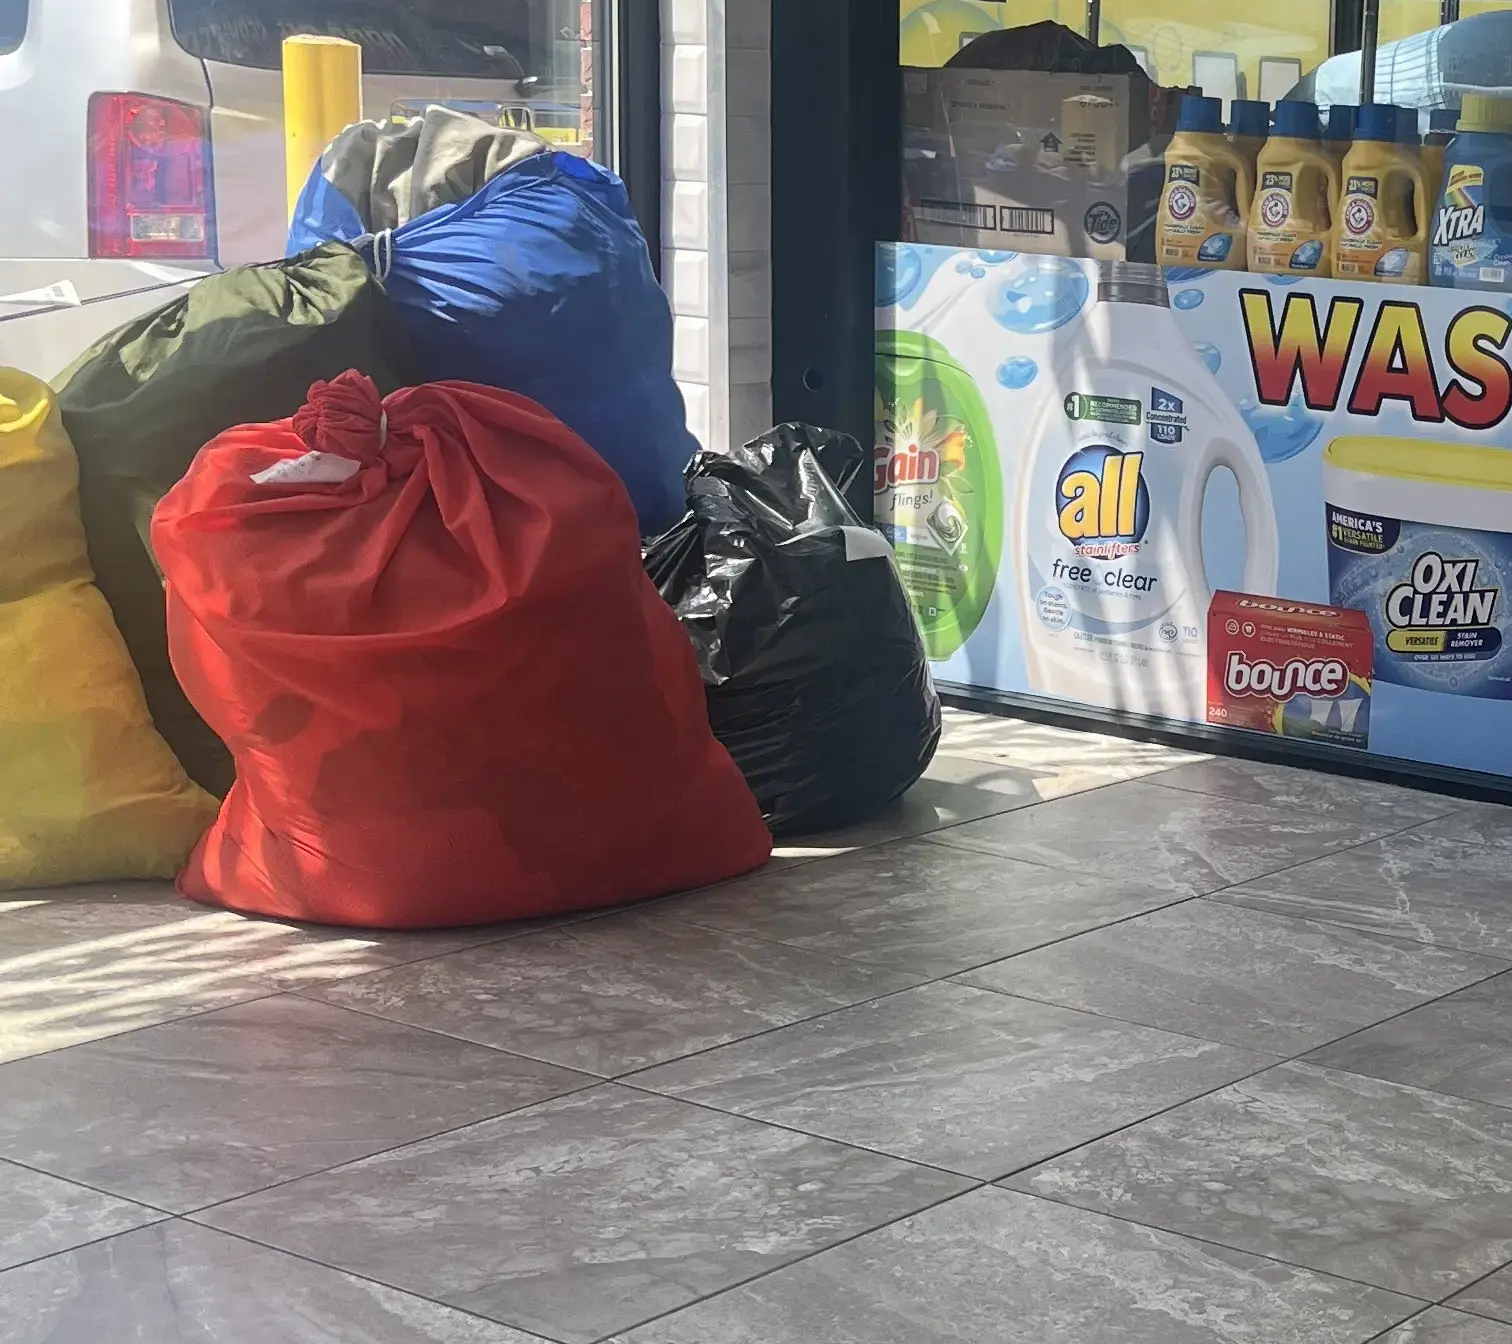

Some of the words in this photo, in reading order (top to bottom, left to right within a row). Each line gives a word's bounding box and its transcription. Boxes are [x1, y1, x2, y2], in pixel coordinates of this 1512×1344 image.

[1088, 211, 1120, 237] Tide
[1433, 204, 1486, 247] XTRA
[1157, 398, 1176, 412] 2x
[1146, 411, 1188, 425] Concentrated
[1157, 424, 1176, 435] 110
[891, 490, 934, 511] flings!
[1058, 451, 1144, 541] all
[1332, 511, 1383, 533] AMERICA'S
[1344, 529, 1383, 543] VERSATILE
[1073, 541, 1141, 558] stainlifters
[1052, 558, 1092, 583] free
[1104, 568, 1158, 593] clear
[1412, 550, 1480, 594] OXI
[1238, 599, 1340, 618] bounce
[1386, 586, 1499, 628] CLEAN
[1405, 636, 1438, 646] VERSATILE
[1450, 639, 1483, 648] REMOVER
[1457, 632, 1478, 640] STAIN
[1227, 652, 1347, 701] bounce
[1208, 706, 1228, 718] 240
